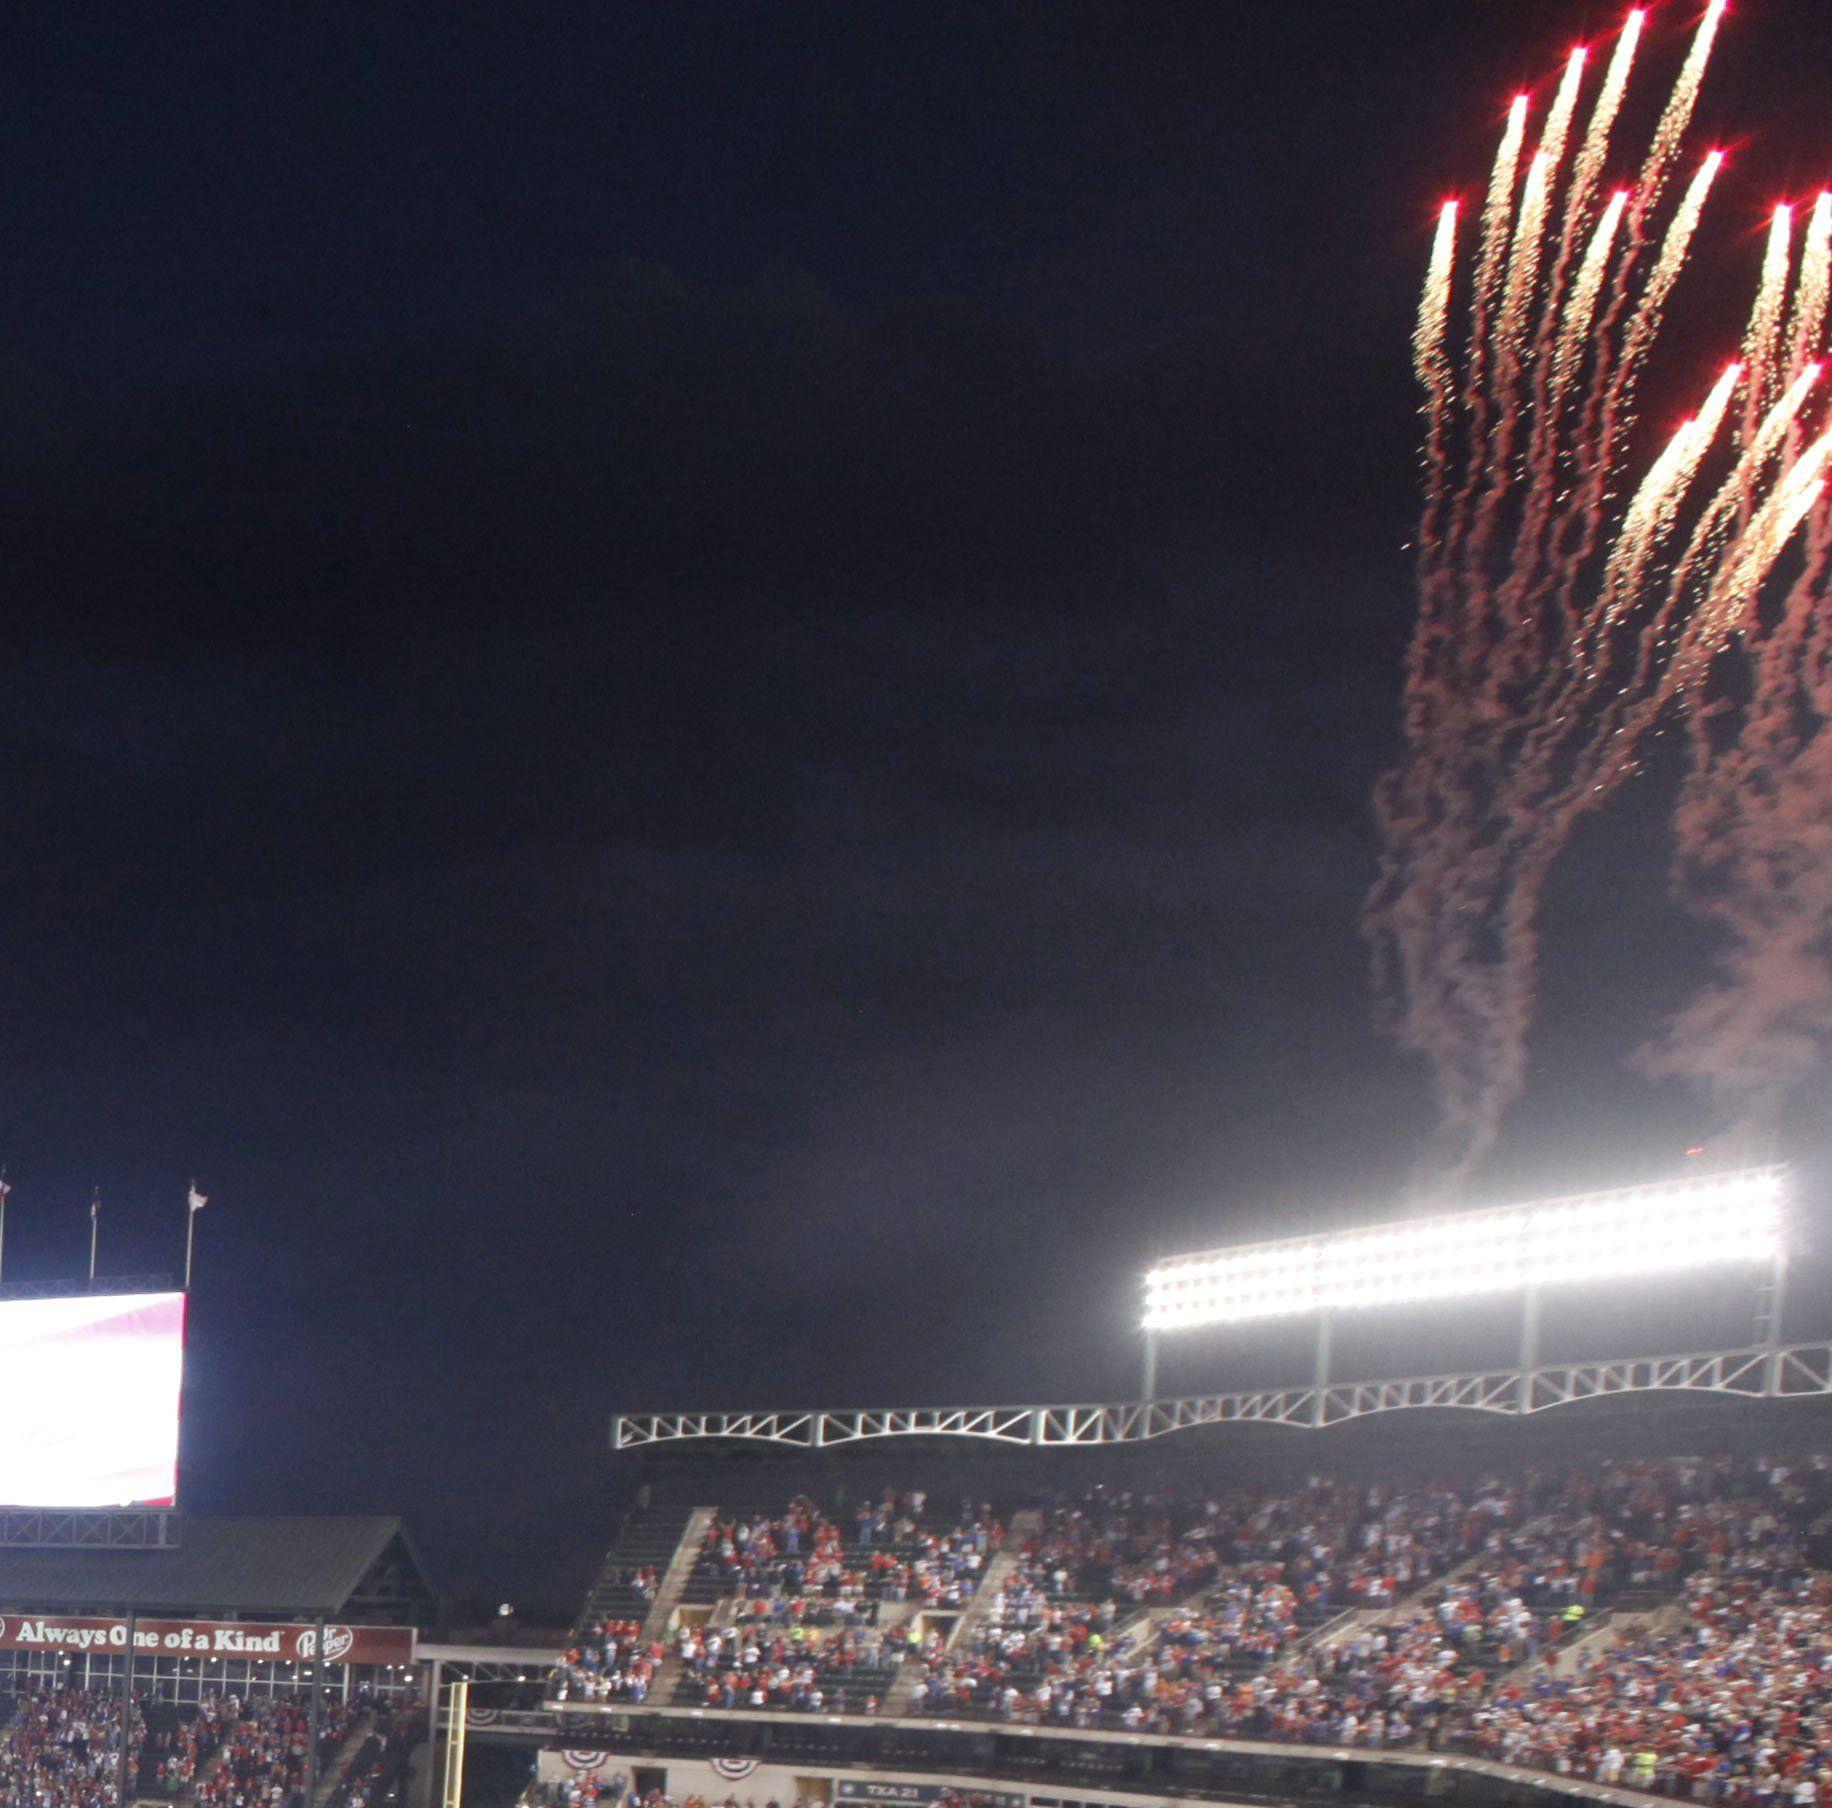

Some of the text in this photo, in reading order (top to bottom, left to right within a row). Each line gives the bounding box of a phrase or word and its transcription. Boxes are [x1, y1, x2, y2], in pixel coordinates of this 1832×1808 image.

[16, 1622, 107, 1648] Always
[164, 1629, 194, 1650] of
[195, 1636, 209, 1651] a
[213, 1631, 281, 1653] Kind
